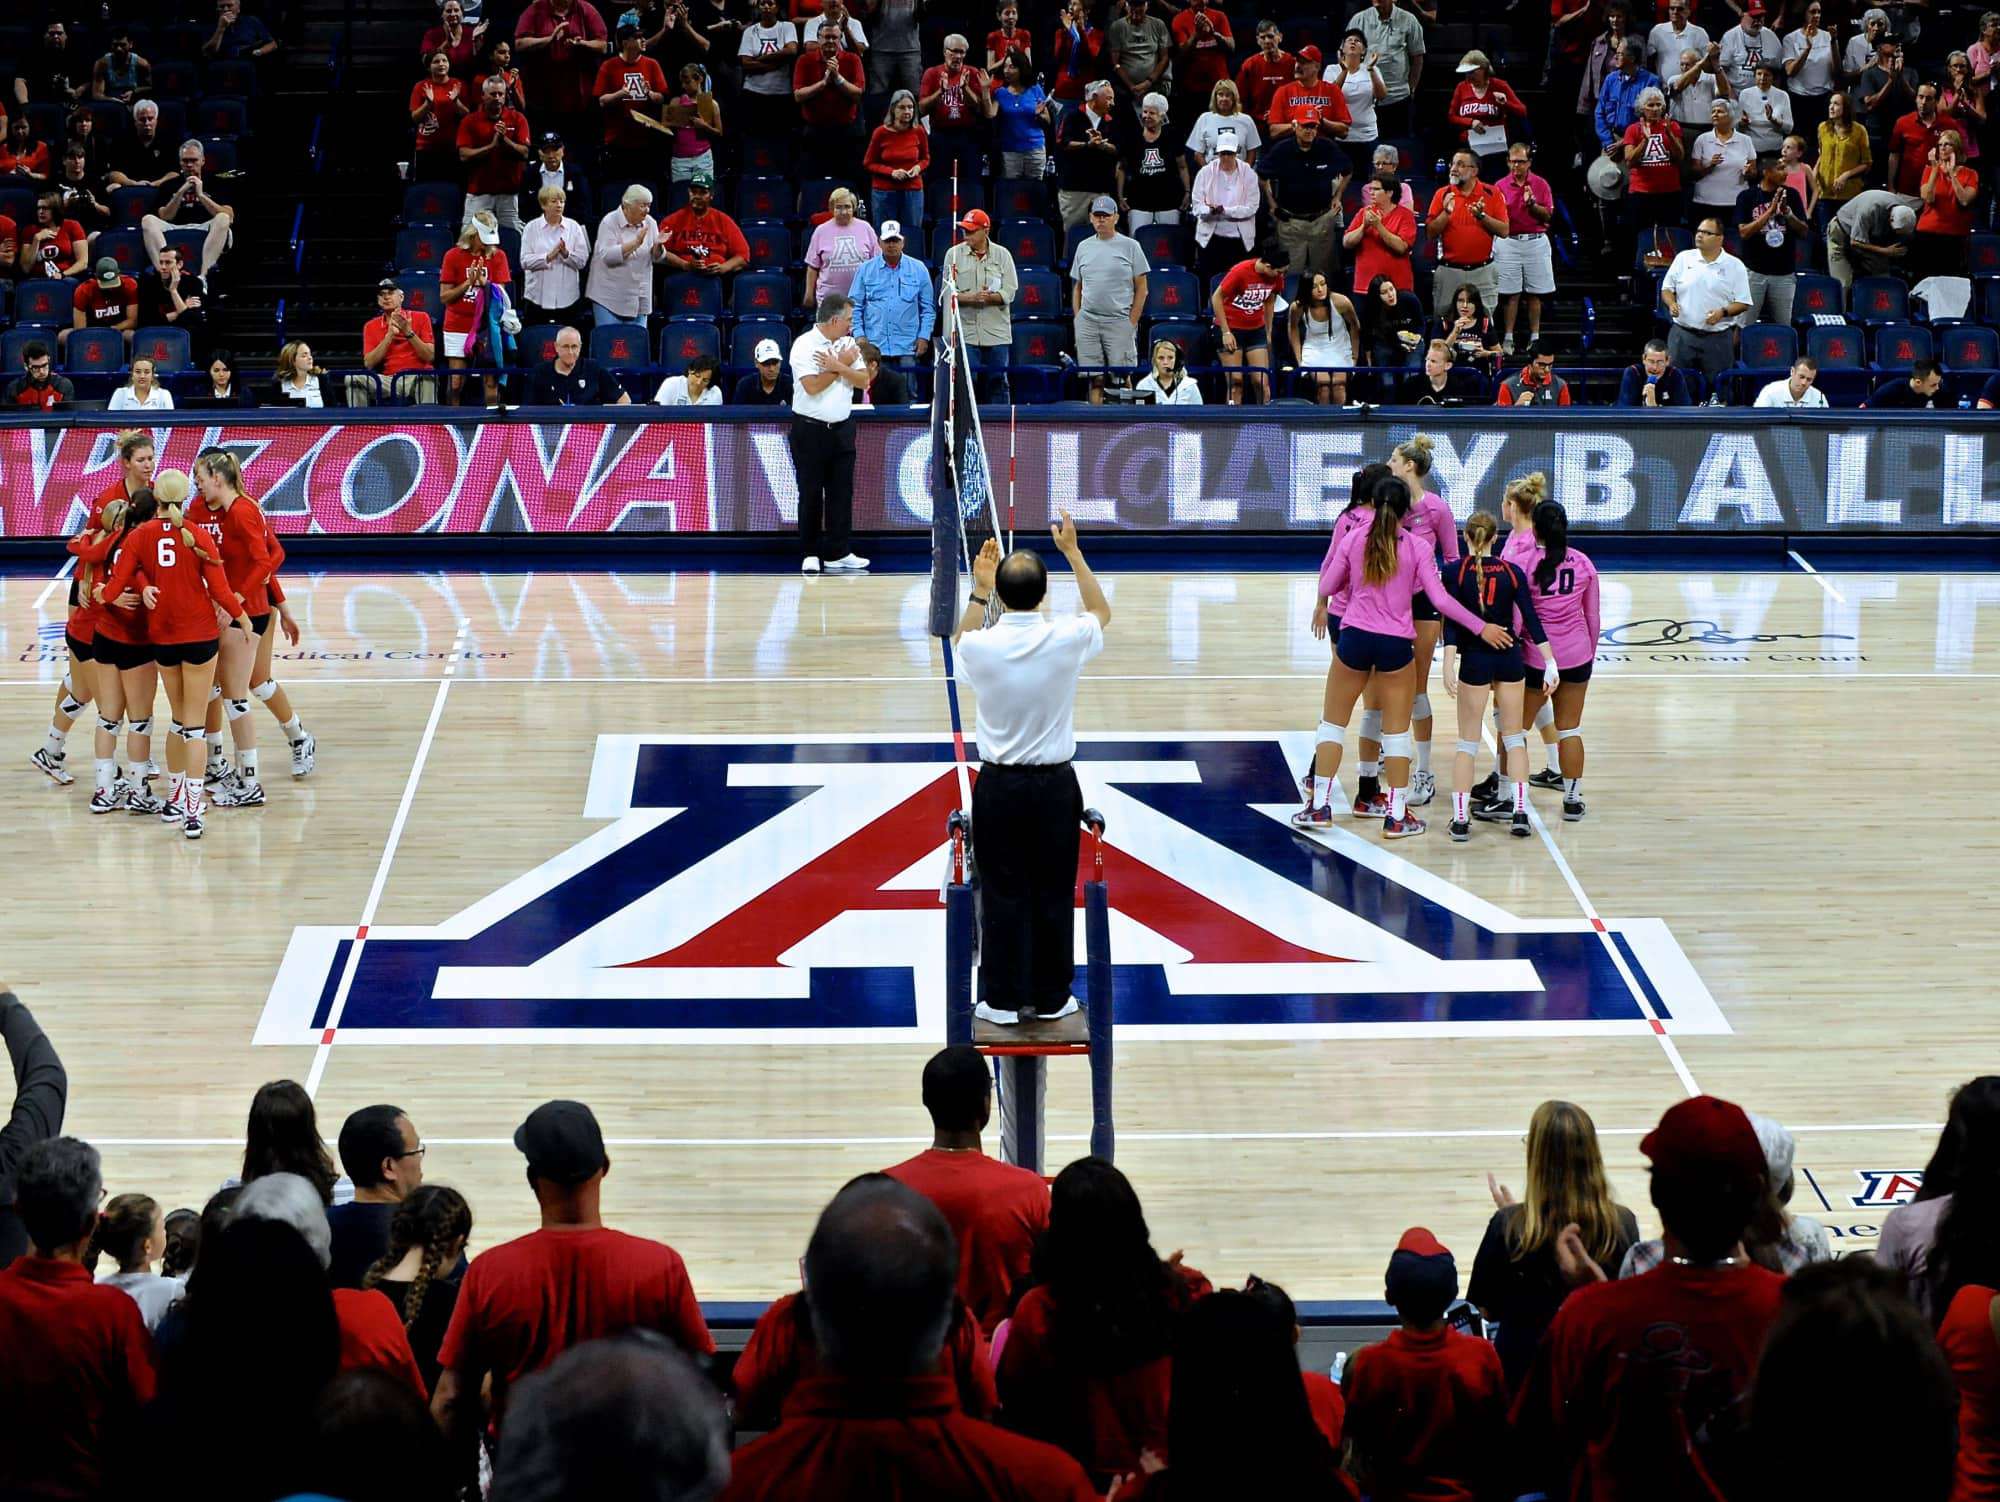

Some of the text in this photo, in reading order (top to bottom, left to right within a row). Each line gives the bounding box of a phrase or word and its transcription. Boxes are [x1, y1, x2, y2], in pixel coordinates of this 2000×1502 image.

[157, 537, 176, 568] 6
[1650, 654, 1752, 663] Olson
[1767, 654, 1873, 663] Court
